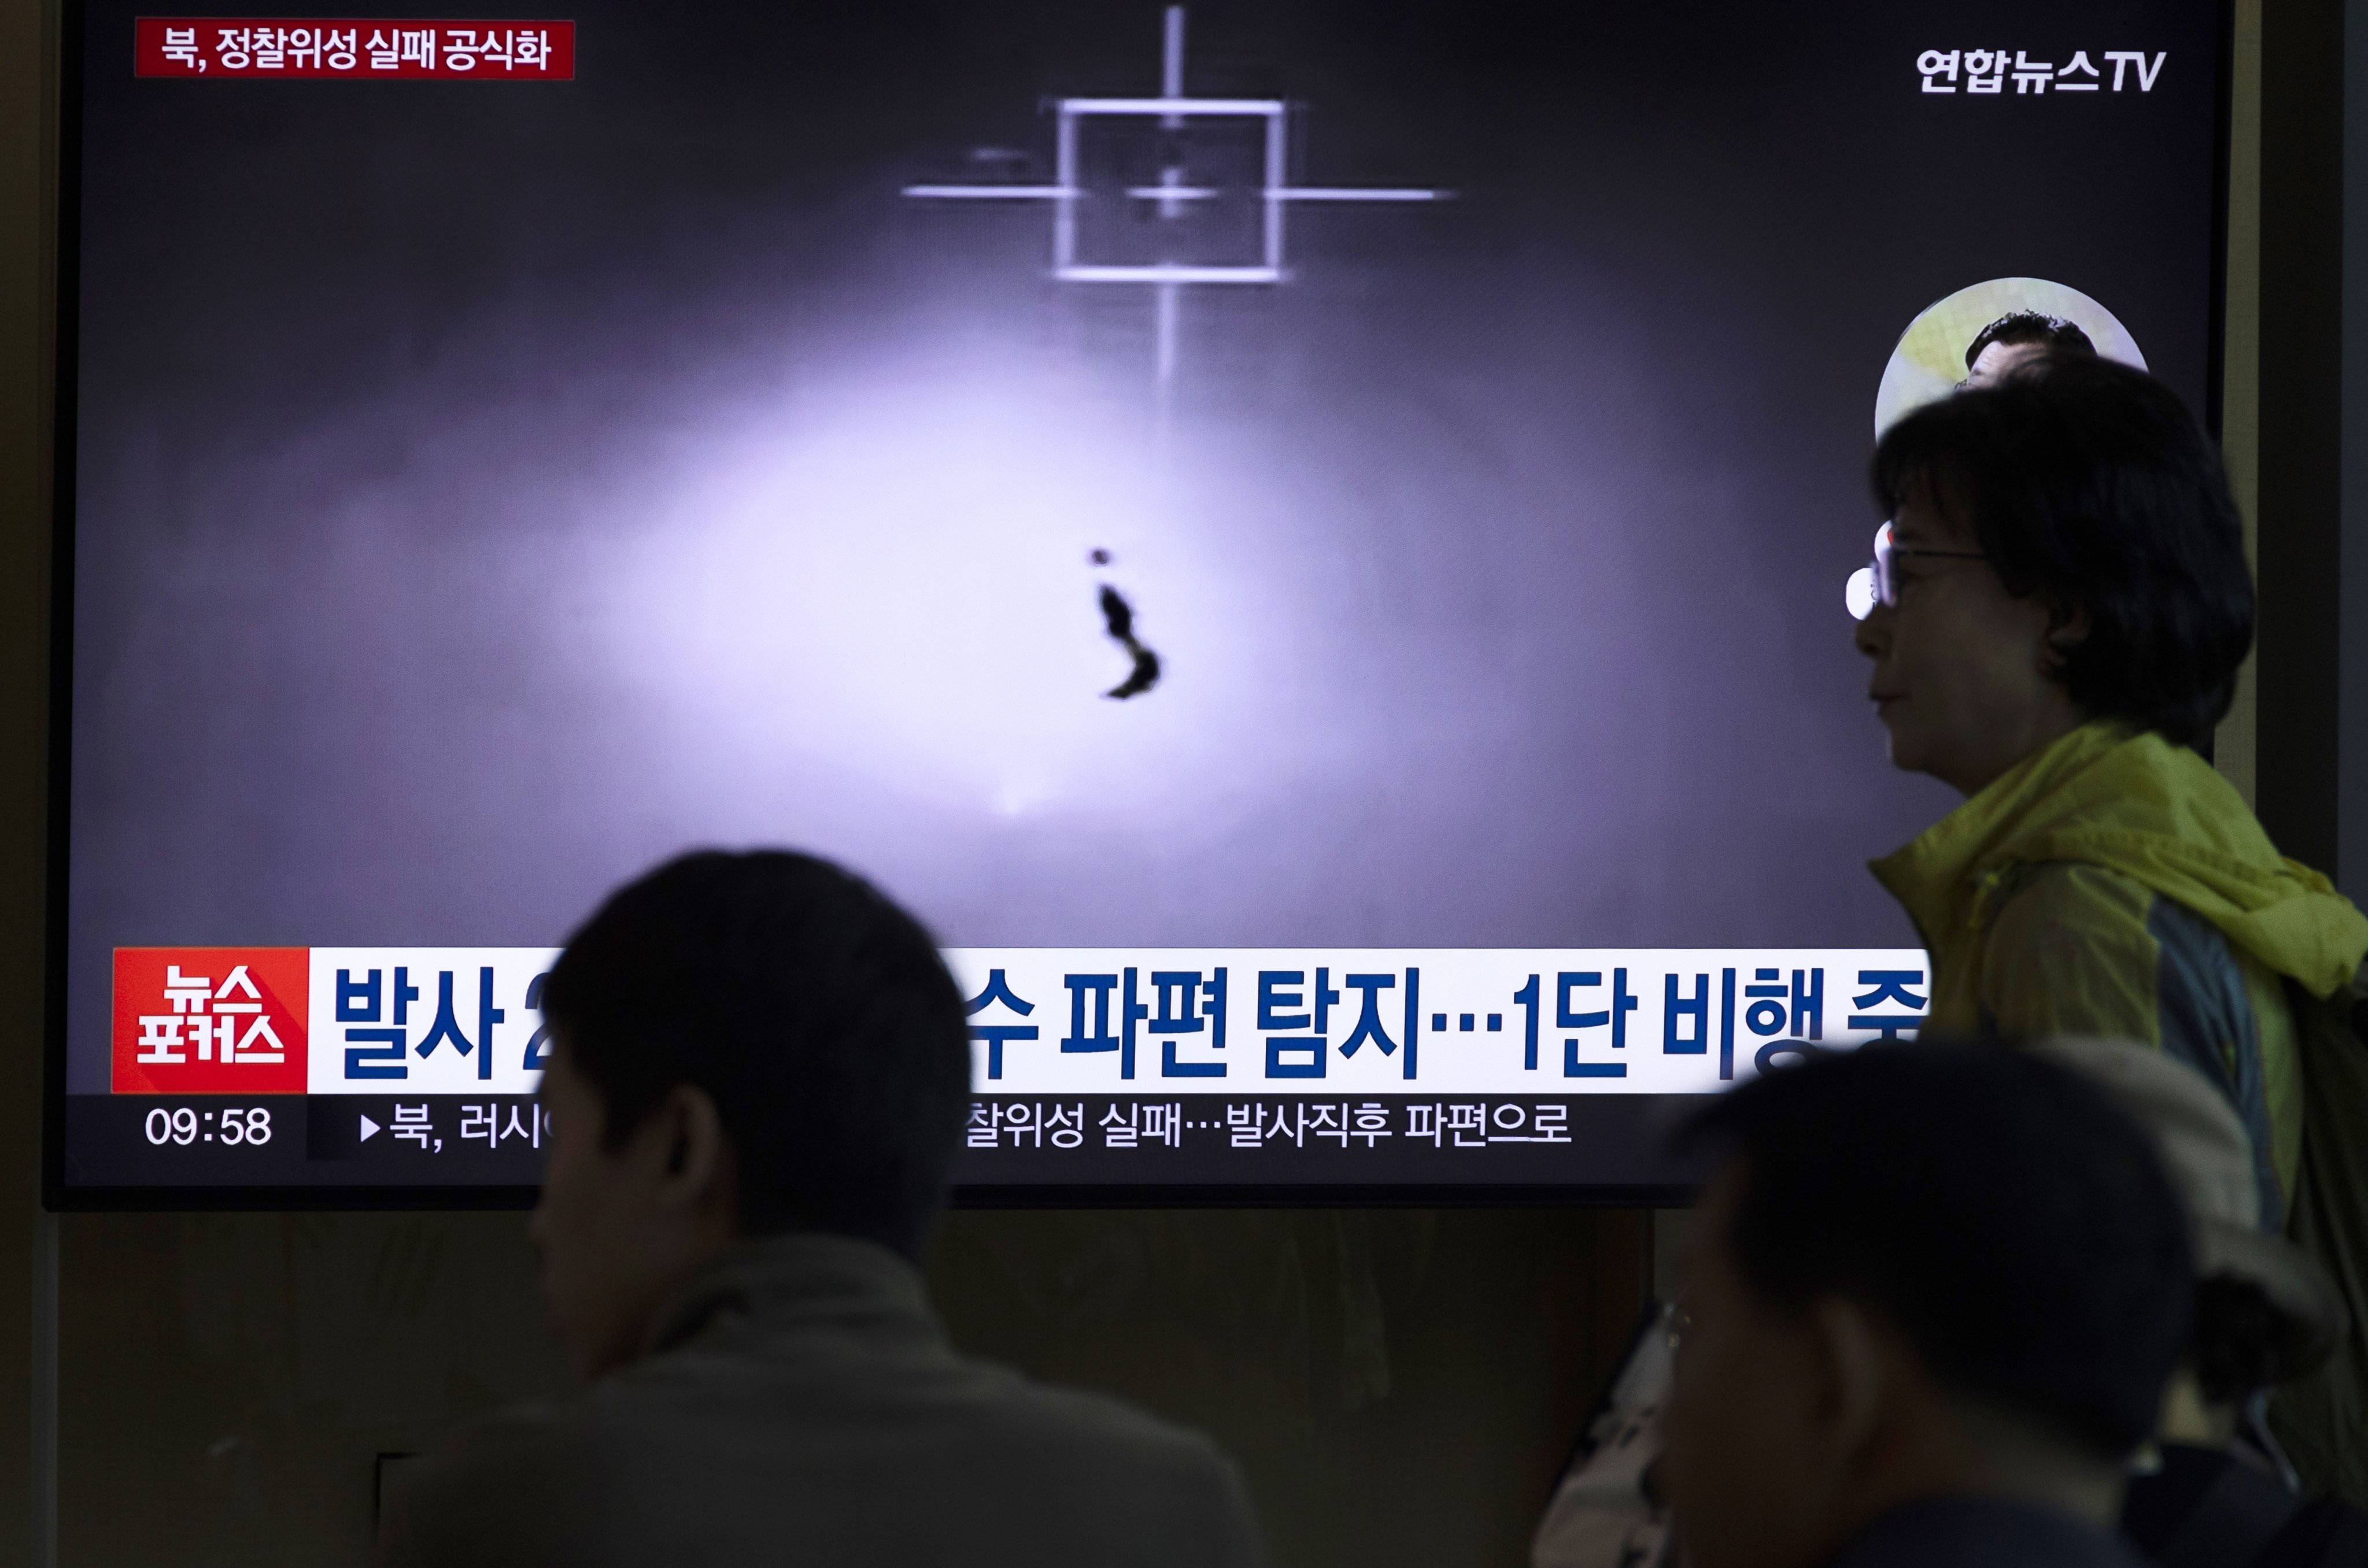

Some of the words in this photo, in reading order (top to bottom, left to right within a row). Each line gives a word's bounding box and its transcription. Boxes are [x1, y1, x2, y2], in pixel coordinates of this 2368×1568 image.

[161, 27, 206, 73] 북,
[216, 28, 357, 69] 정찰위성
[365, 29, 435, 69] 실패
[442, 30, 552, 71] 공식화
[1916, 49, 2167, 94] 연합뉴스TV
[164, 965, 263, 1013] 뉴스
[137, 1015, 285, 1063] 포커스
[335, 966, 505, 1080] 발사
[1060, 967, 1228, 1080] 파편
[1663, 968, 1824, 1080] 비행
[145, 1107, 272, 1145] 09:58
[390, 1104, 442, 1153] 북,
[1405, 1103, 1572, 1148] 파편으로
